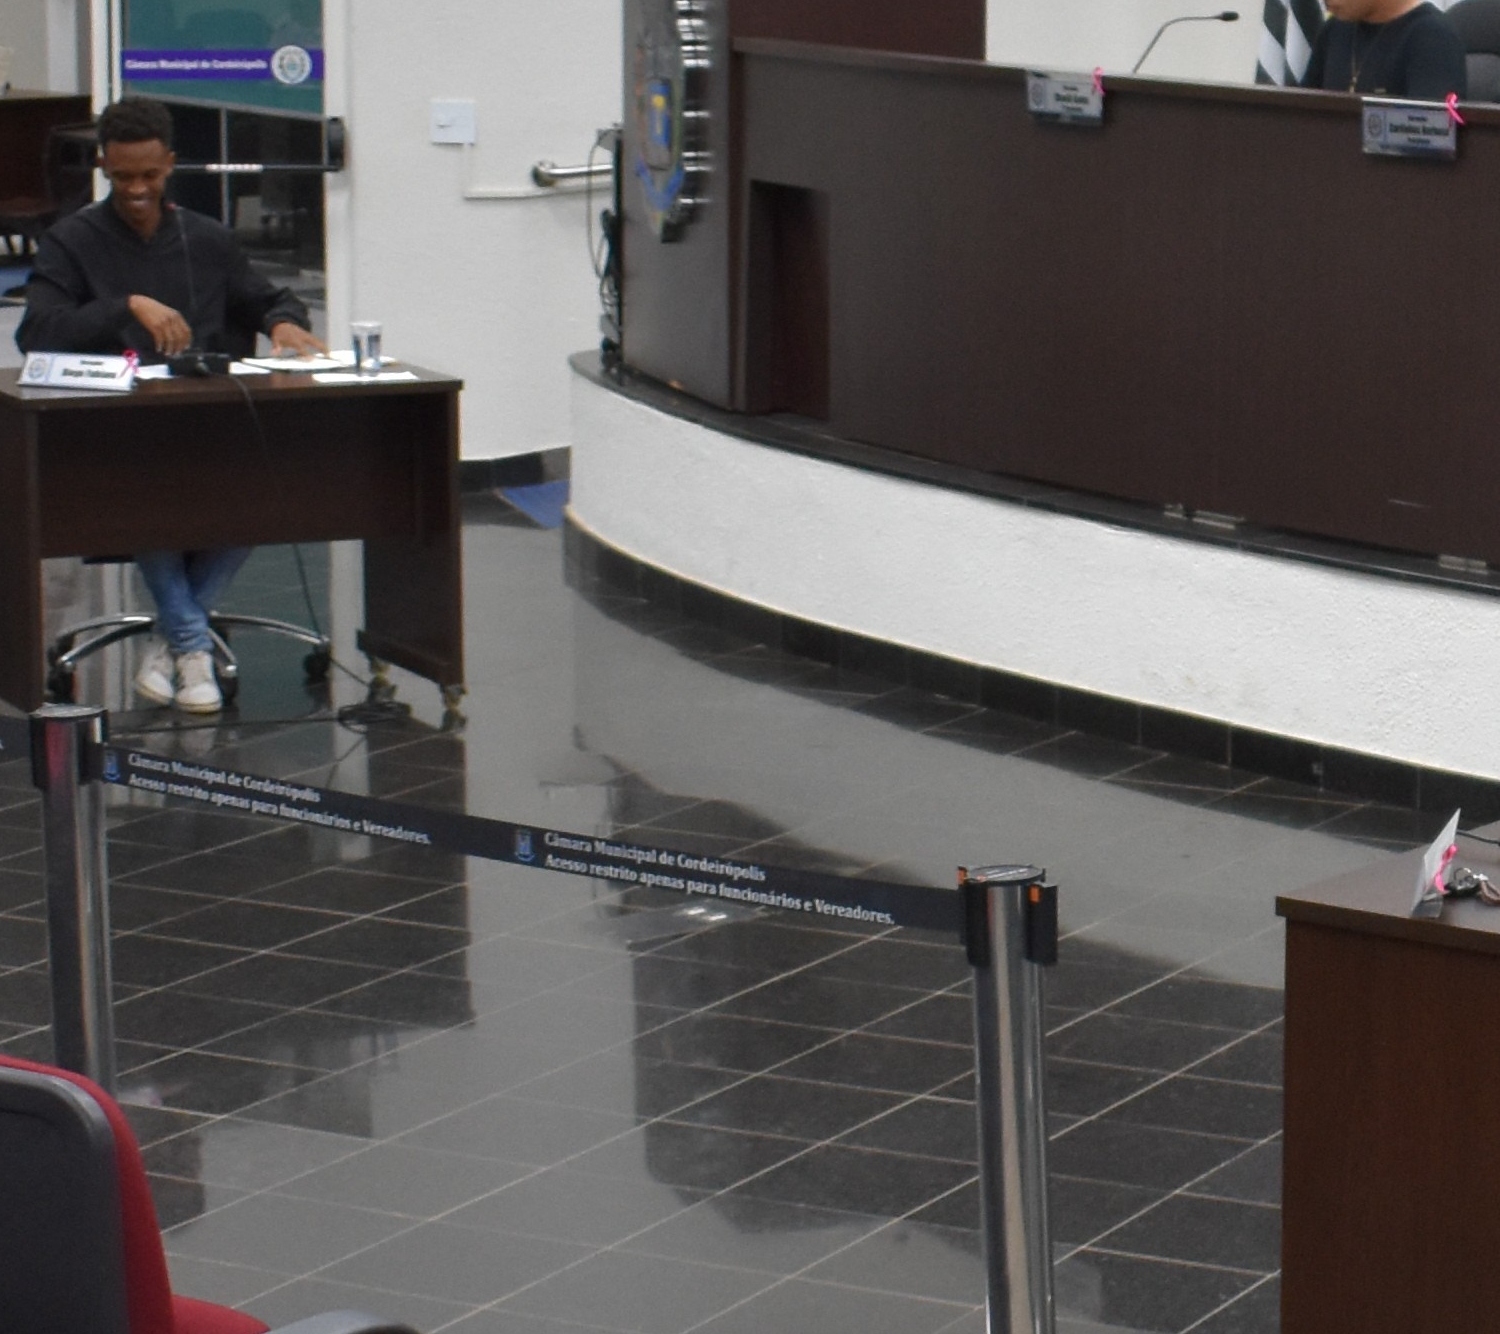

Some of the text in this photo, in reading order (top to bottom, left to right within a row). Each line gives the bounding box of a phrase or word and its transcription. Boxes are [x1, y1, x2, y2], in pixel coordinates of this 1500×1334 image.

[544, 832, 766, 882] Câmara Municipal de Cordeirópolis
[545, 854, 895, 925] Acesso restrito apenas para funcionários e Vereadores.
